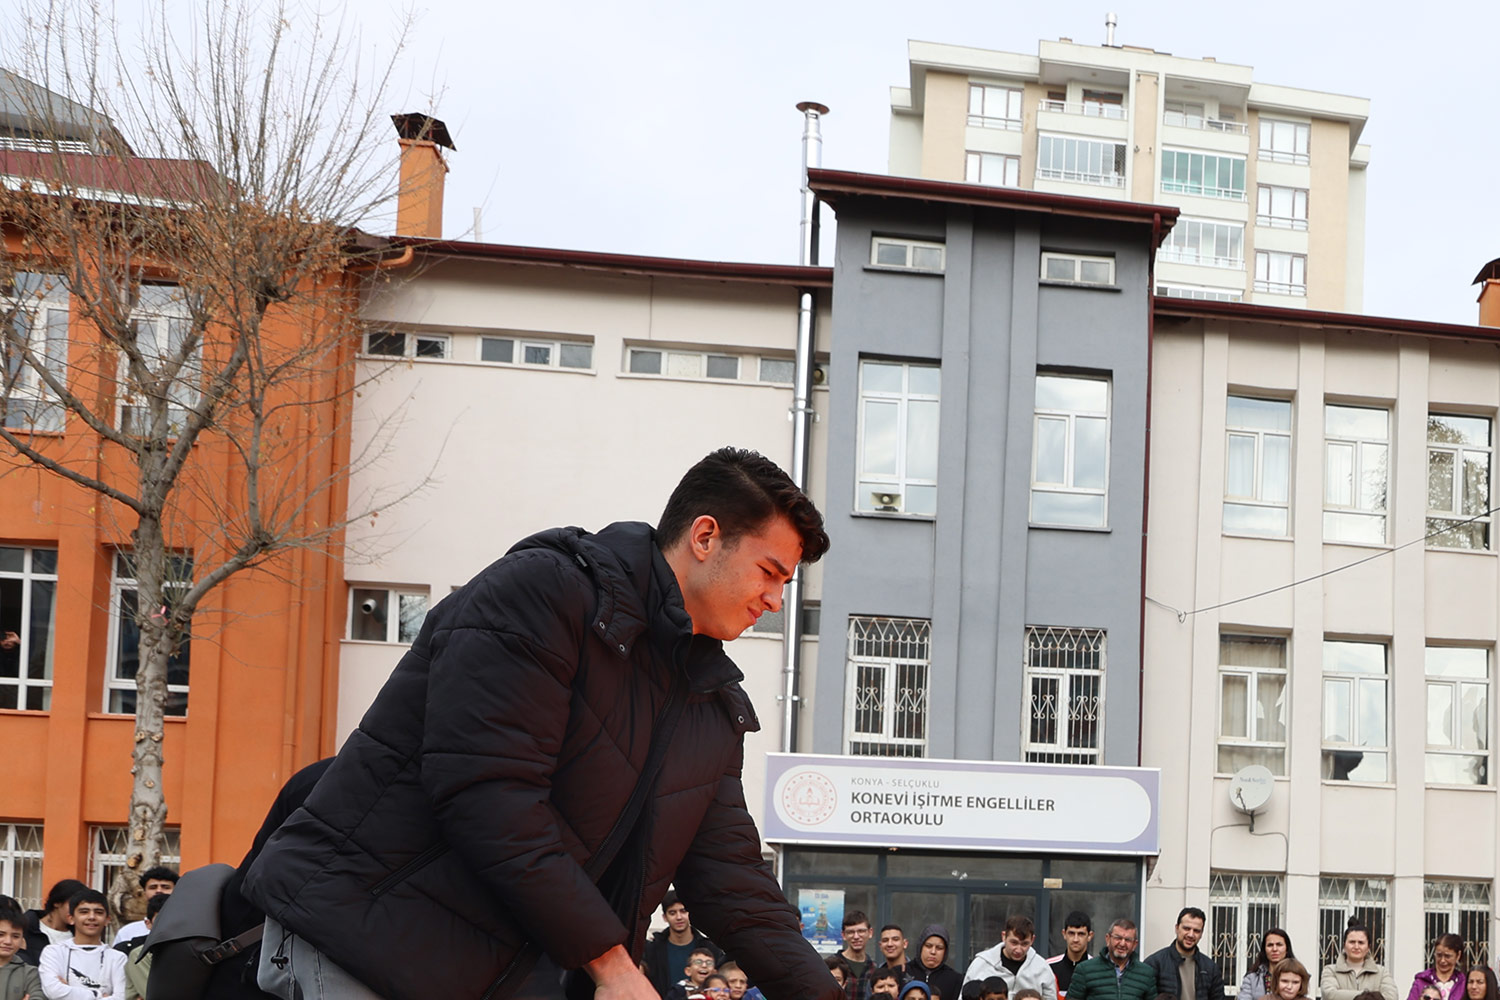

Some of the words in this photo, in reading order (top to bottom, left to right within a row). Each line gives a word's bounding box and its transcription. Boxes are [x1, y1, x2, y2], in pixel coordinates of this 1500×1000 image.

[851, 777, 884, 786] KONYA
[891, 778, 940, 789] SELÇUKLU
[851, 791, 908, 806] KONEVİ
[912, 792, 963, 809] İŞİTME
[966, 796, 1056, 811] ENGELLİLER
[850, 811, 944, 826] ORTAOKULU
